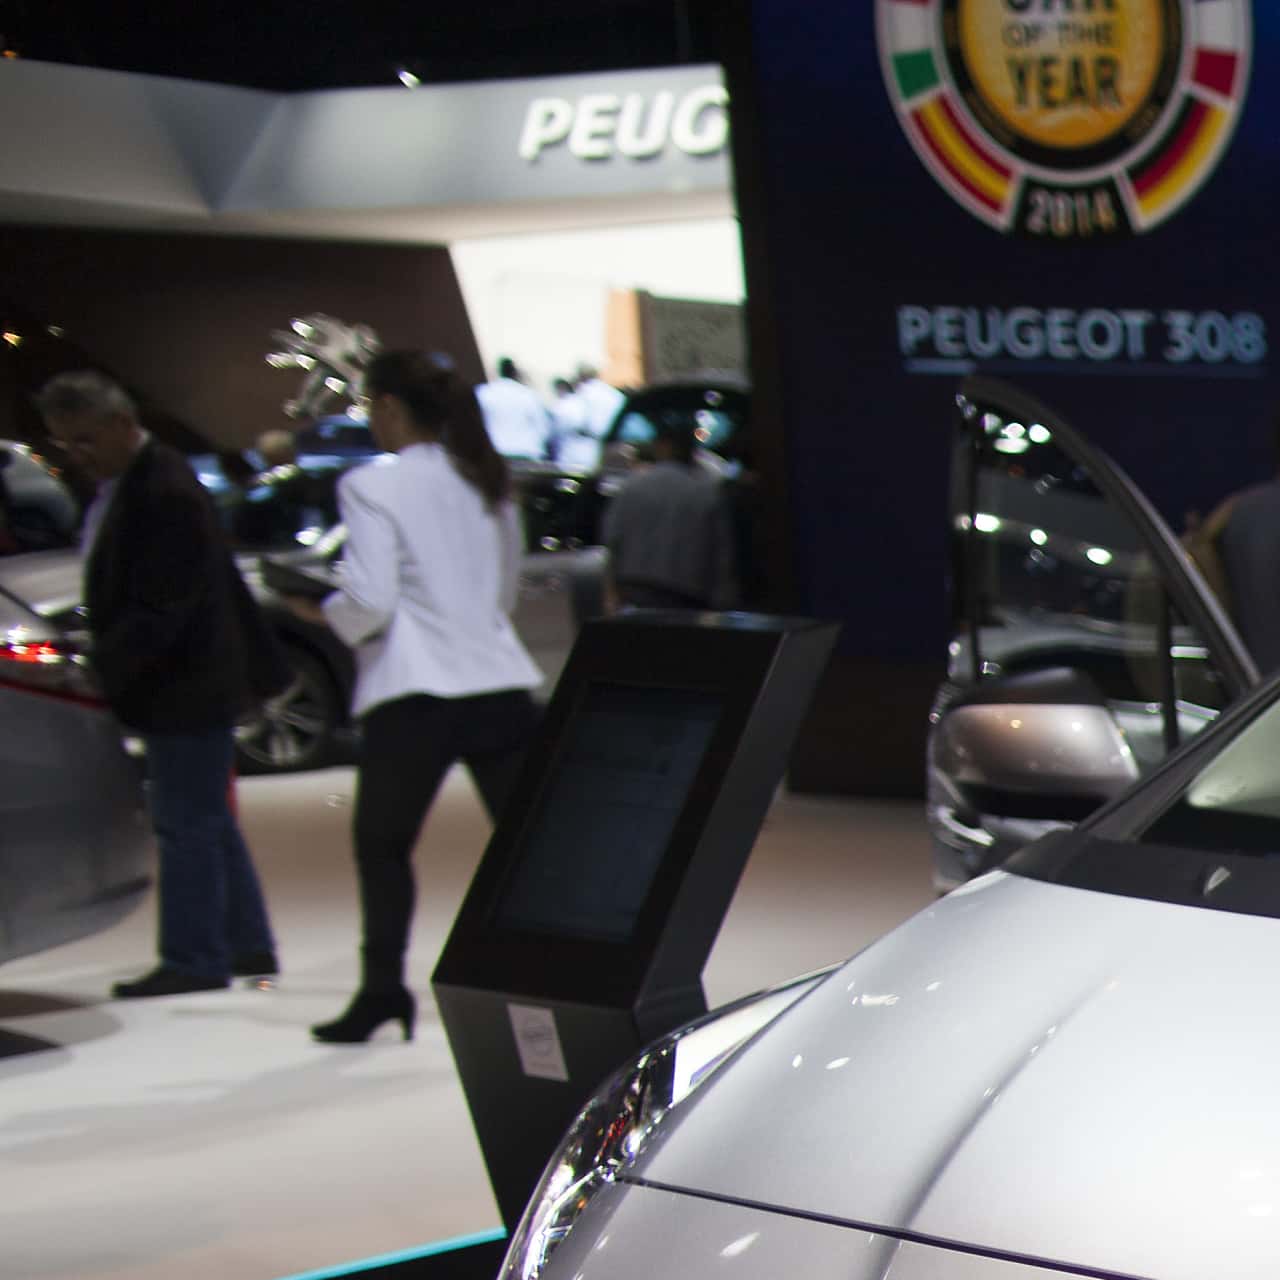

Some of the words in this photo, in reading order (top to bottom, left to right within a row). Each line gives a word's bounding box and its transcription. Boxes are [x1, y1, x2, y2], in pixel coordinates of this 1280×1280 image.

[1003, 21, 1041, 47] OF
[1057, 21, 1116, 47] THE
[1005, 54, 1122, 110] YEAR
[1024, 187, 1119, 236] 2014
[898, 304, 1154, 359] PEUGEOT
[1162, 310, 1266, 362] 308
